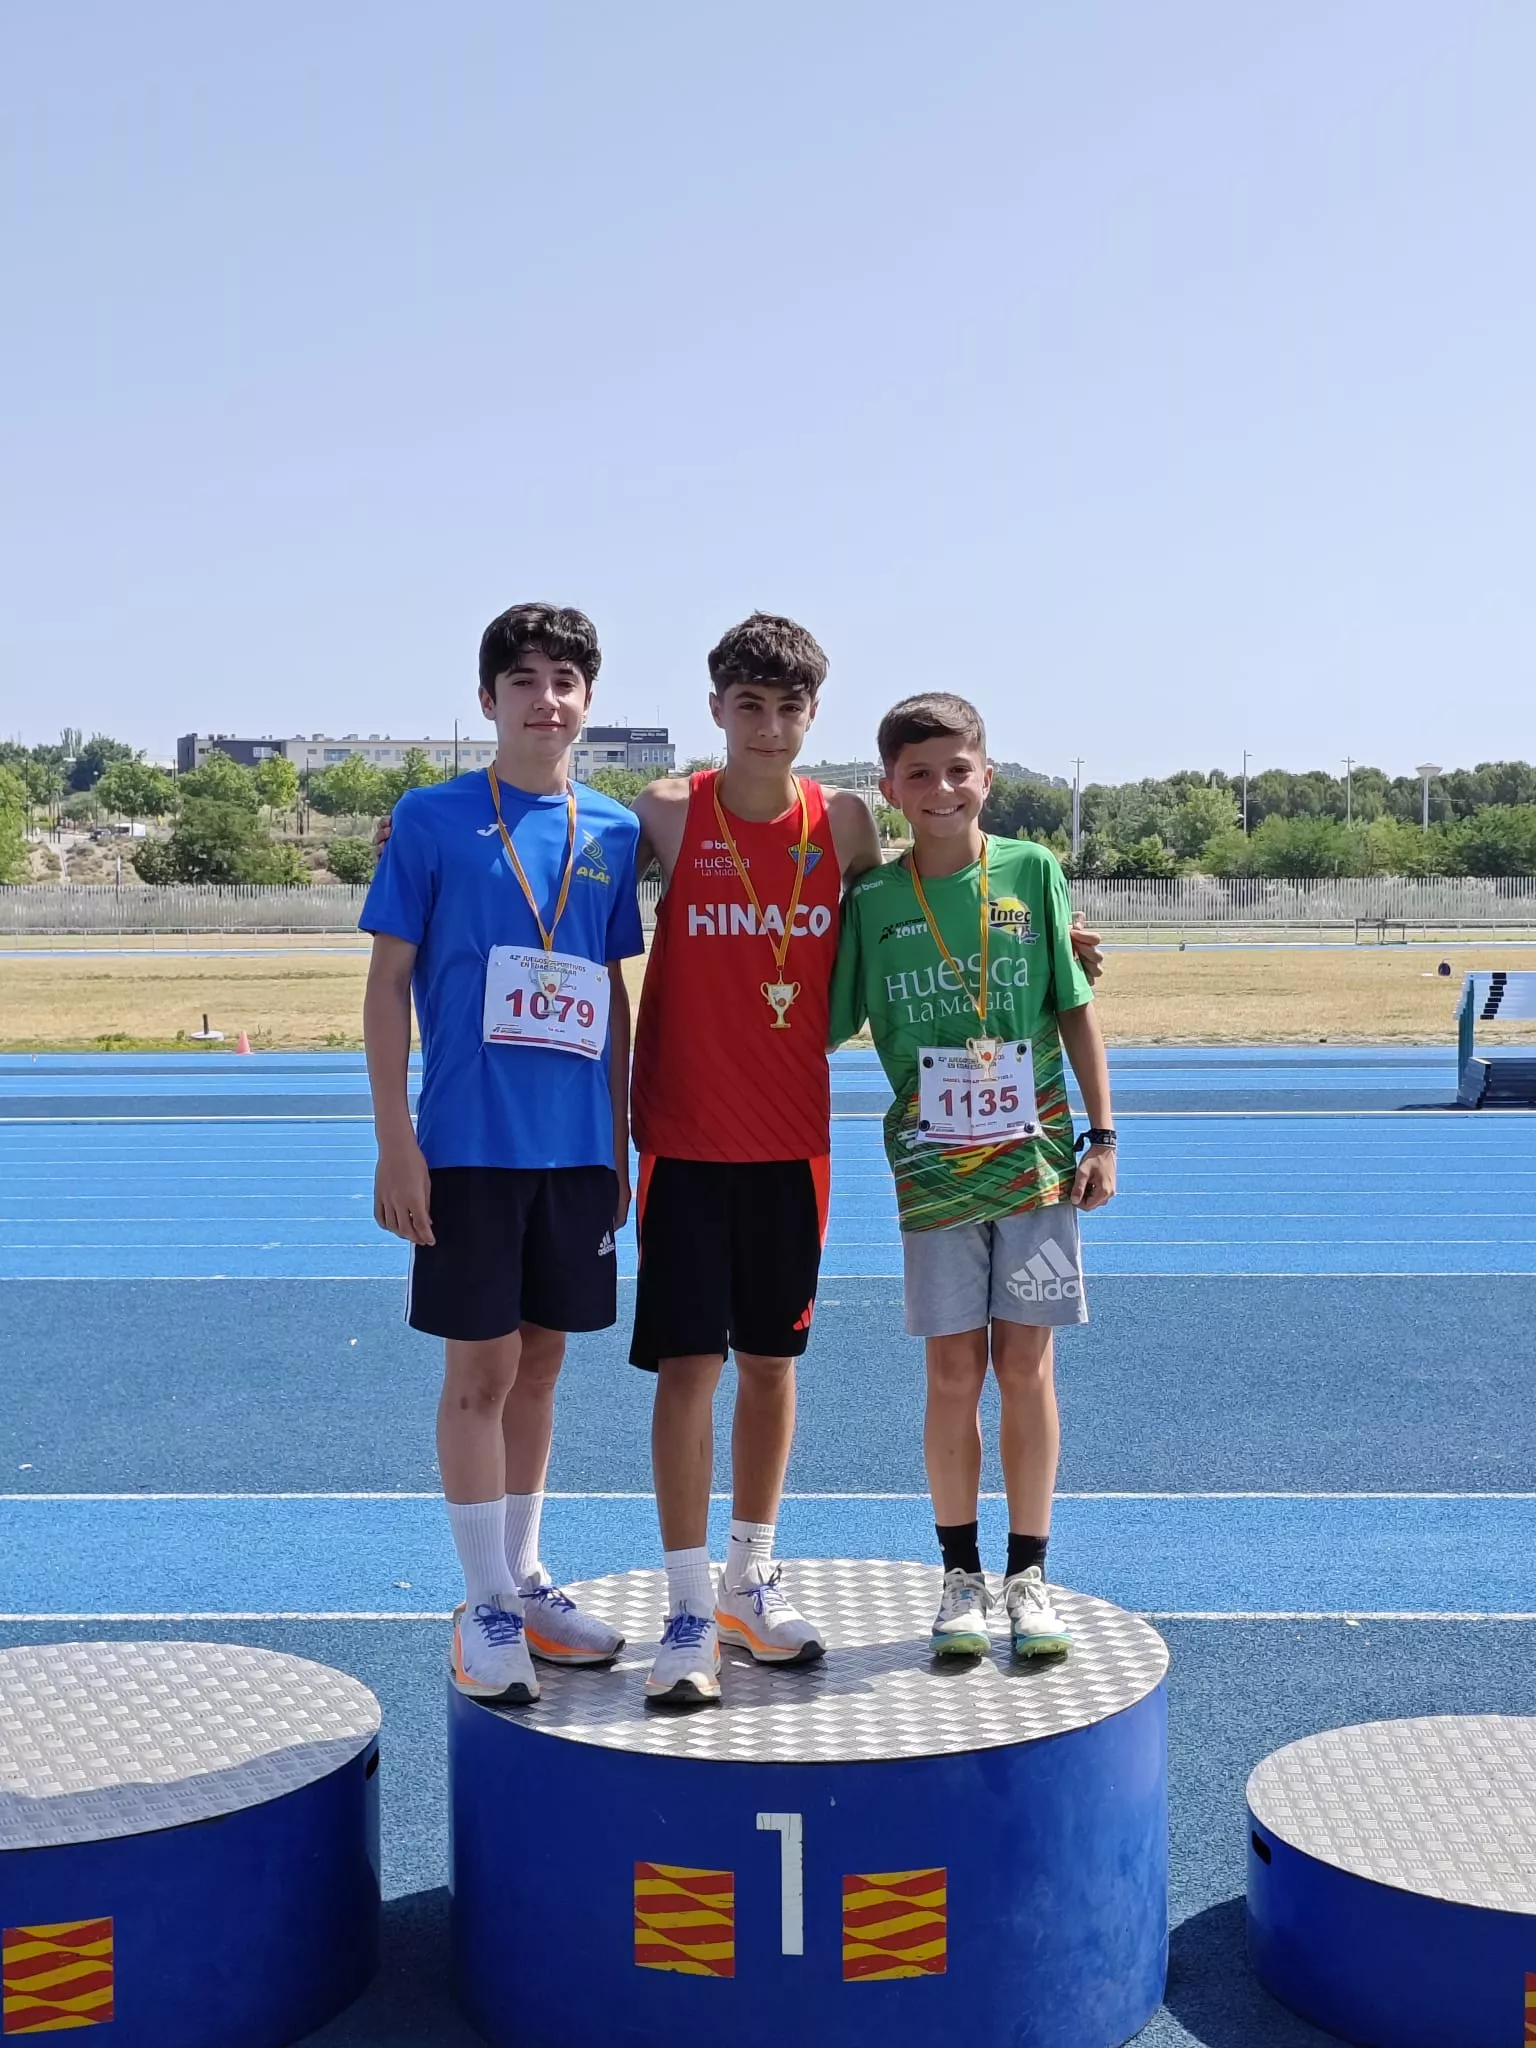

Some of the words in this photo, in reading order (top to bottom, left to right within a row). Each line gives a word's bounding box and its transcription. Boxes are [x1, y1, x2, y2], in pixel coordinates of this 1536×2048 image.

[694, 856, 750, 868] Huesa
[687, 903, 832, 938] HINACO
[884, 952, 1030, 1003] Huesca
[505, 988, 595, 1029] 1079
[907, 1002, 934, 1024] La
[938, 1085, 1019, 1118] 1135
[1006, 1276, 1080, 1302] adida
[755, 1812, 804, 1956] 1
